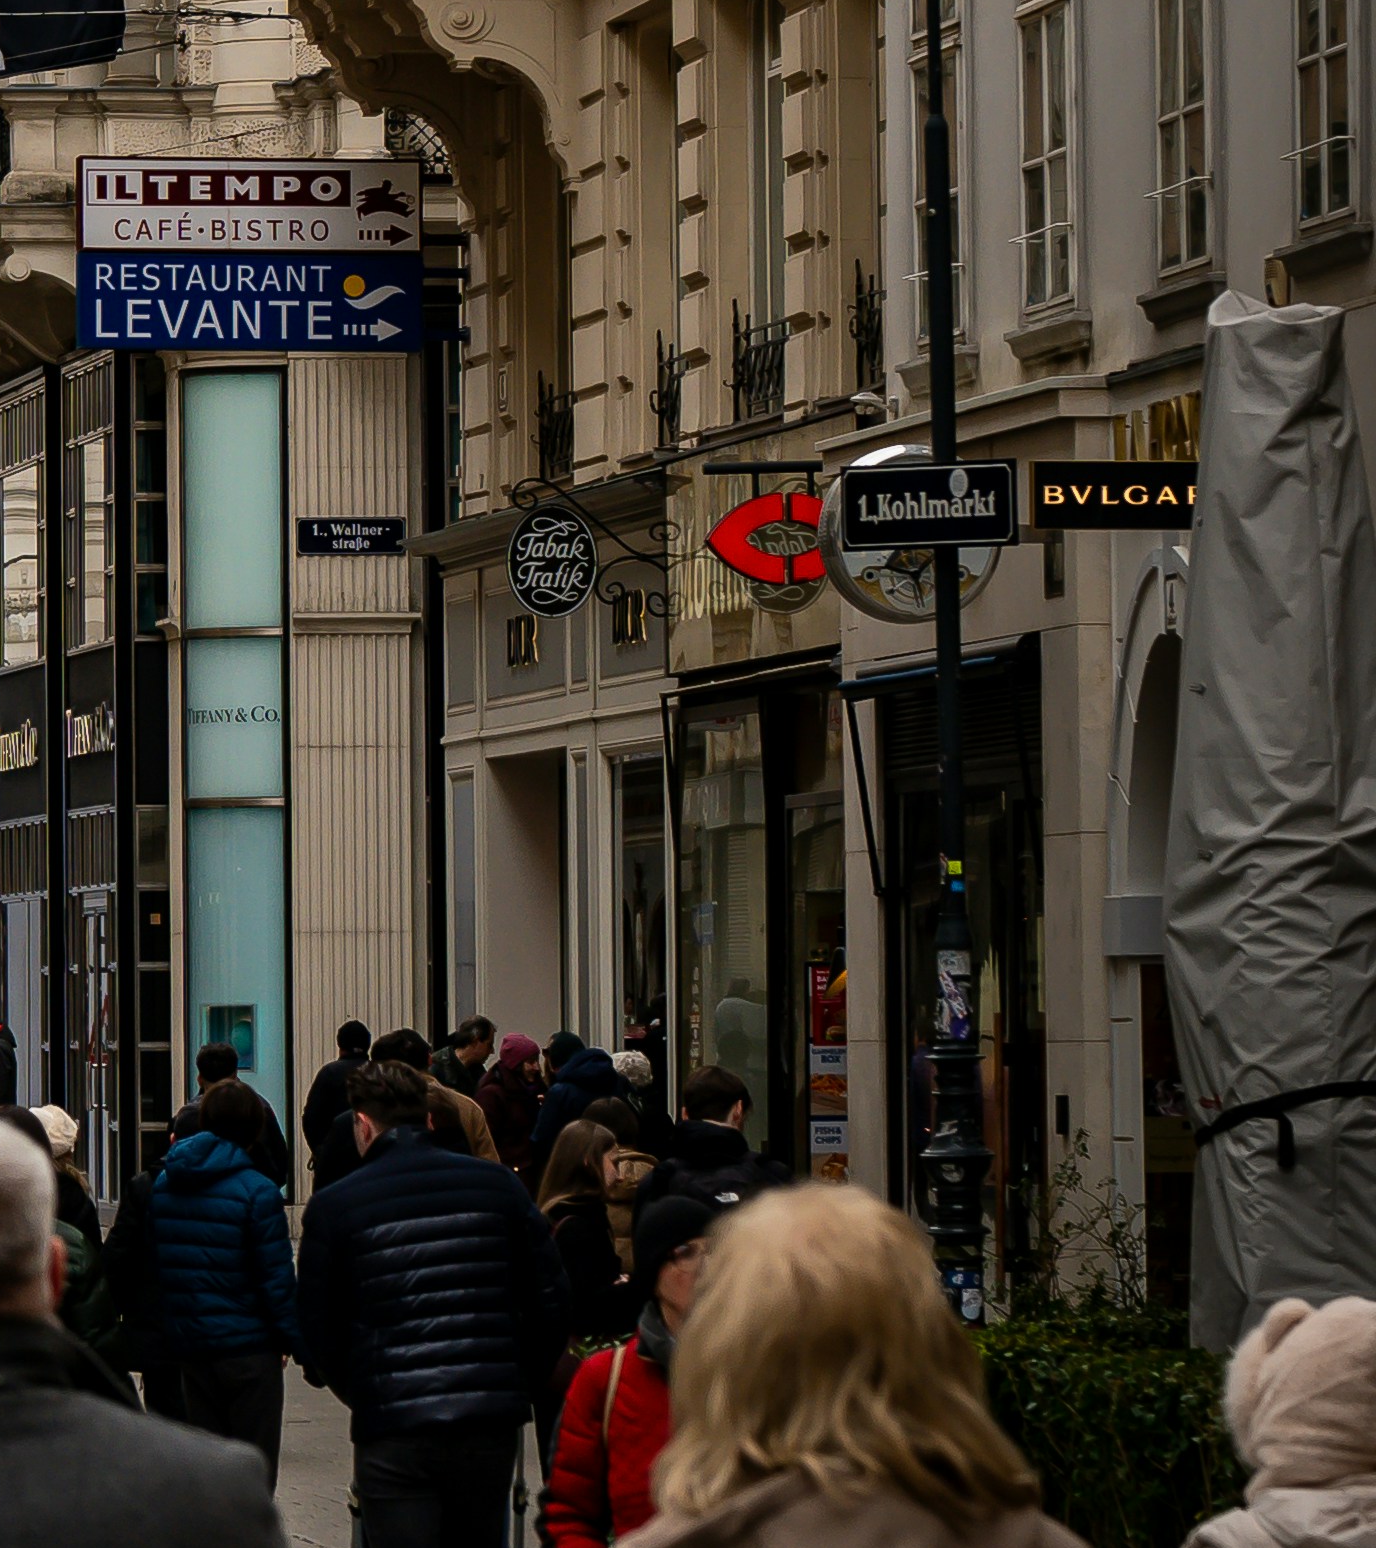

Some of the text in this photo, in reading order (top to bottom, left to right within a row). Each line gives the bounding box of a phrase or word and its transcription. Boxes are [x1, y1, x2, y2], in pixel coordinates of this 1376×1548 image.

[95, 174, 343, 202] IL TEMPO
[95, 262, 333, 293] RESTAURANT
[96, 298, 334, 341] LEVANTE
[517, 532, 589, 561] Tabak
[517, 561, 589, 590] Trafik
[234, 709, 247, 723] &
